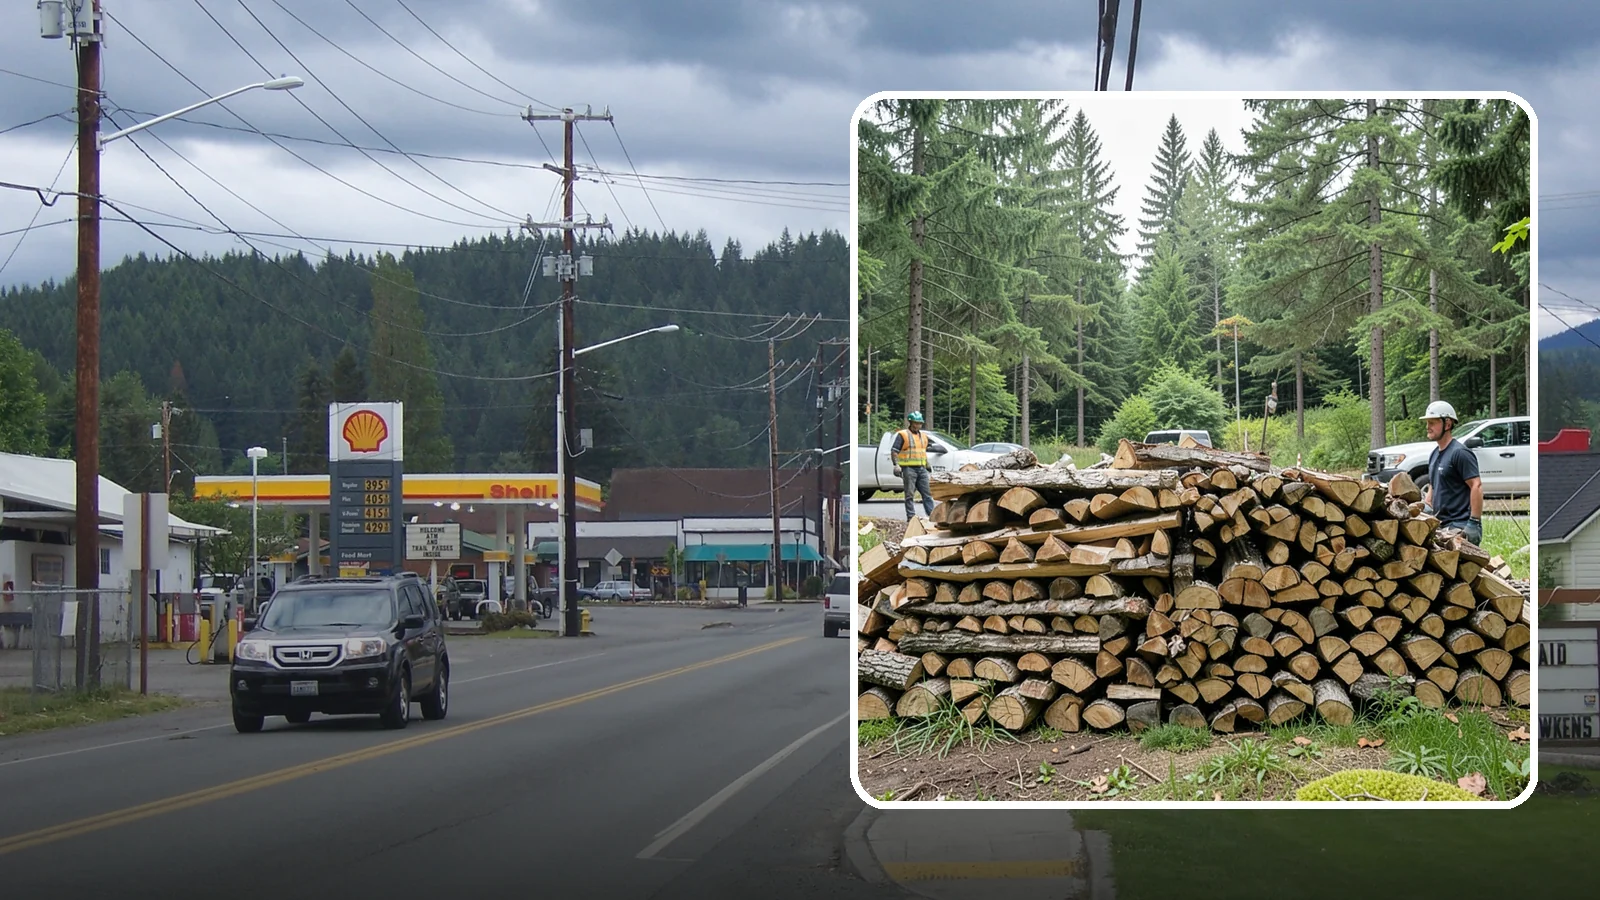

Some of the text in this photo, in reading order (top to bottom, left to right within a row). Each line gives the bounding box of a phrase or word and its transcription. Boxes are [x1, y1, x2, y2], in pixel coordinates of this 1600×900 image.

[366, 480, 384, 490] 395
[490, 484, 547, 498] Shell
[366, 494, 384, 504] 405
[366, 508, 383, 518] 415
[366, 522, 384, 532] 429
[1538, 642, 1567, 665] AID
